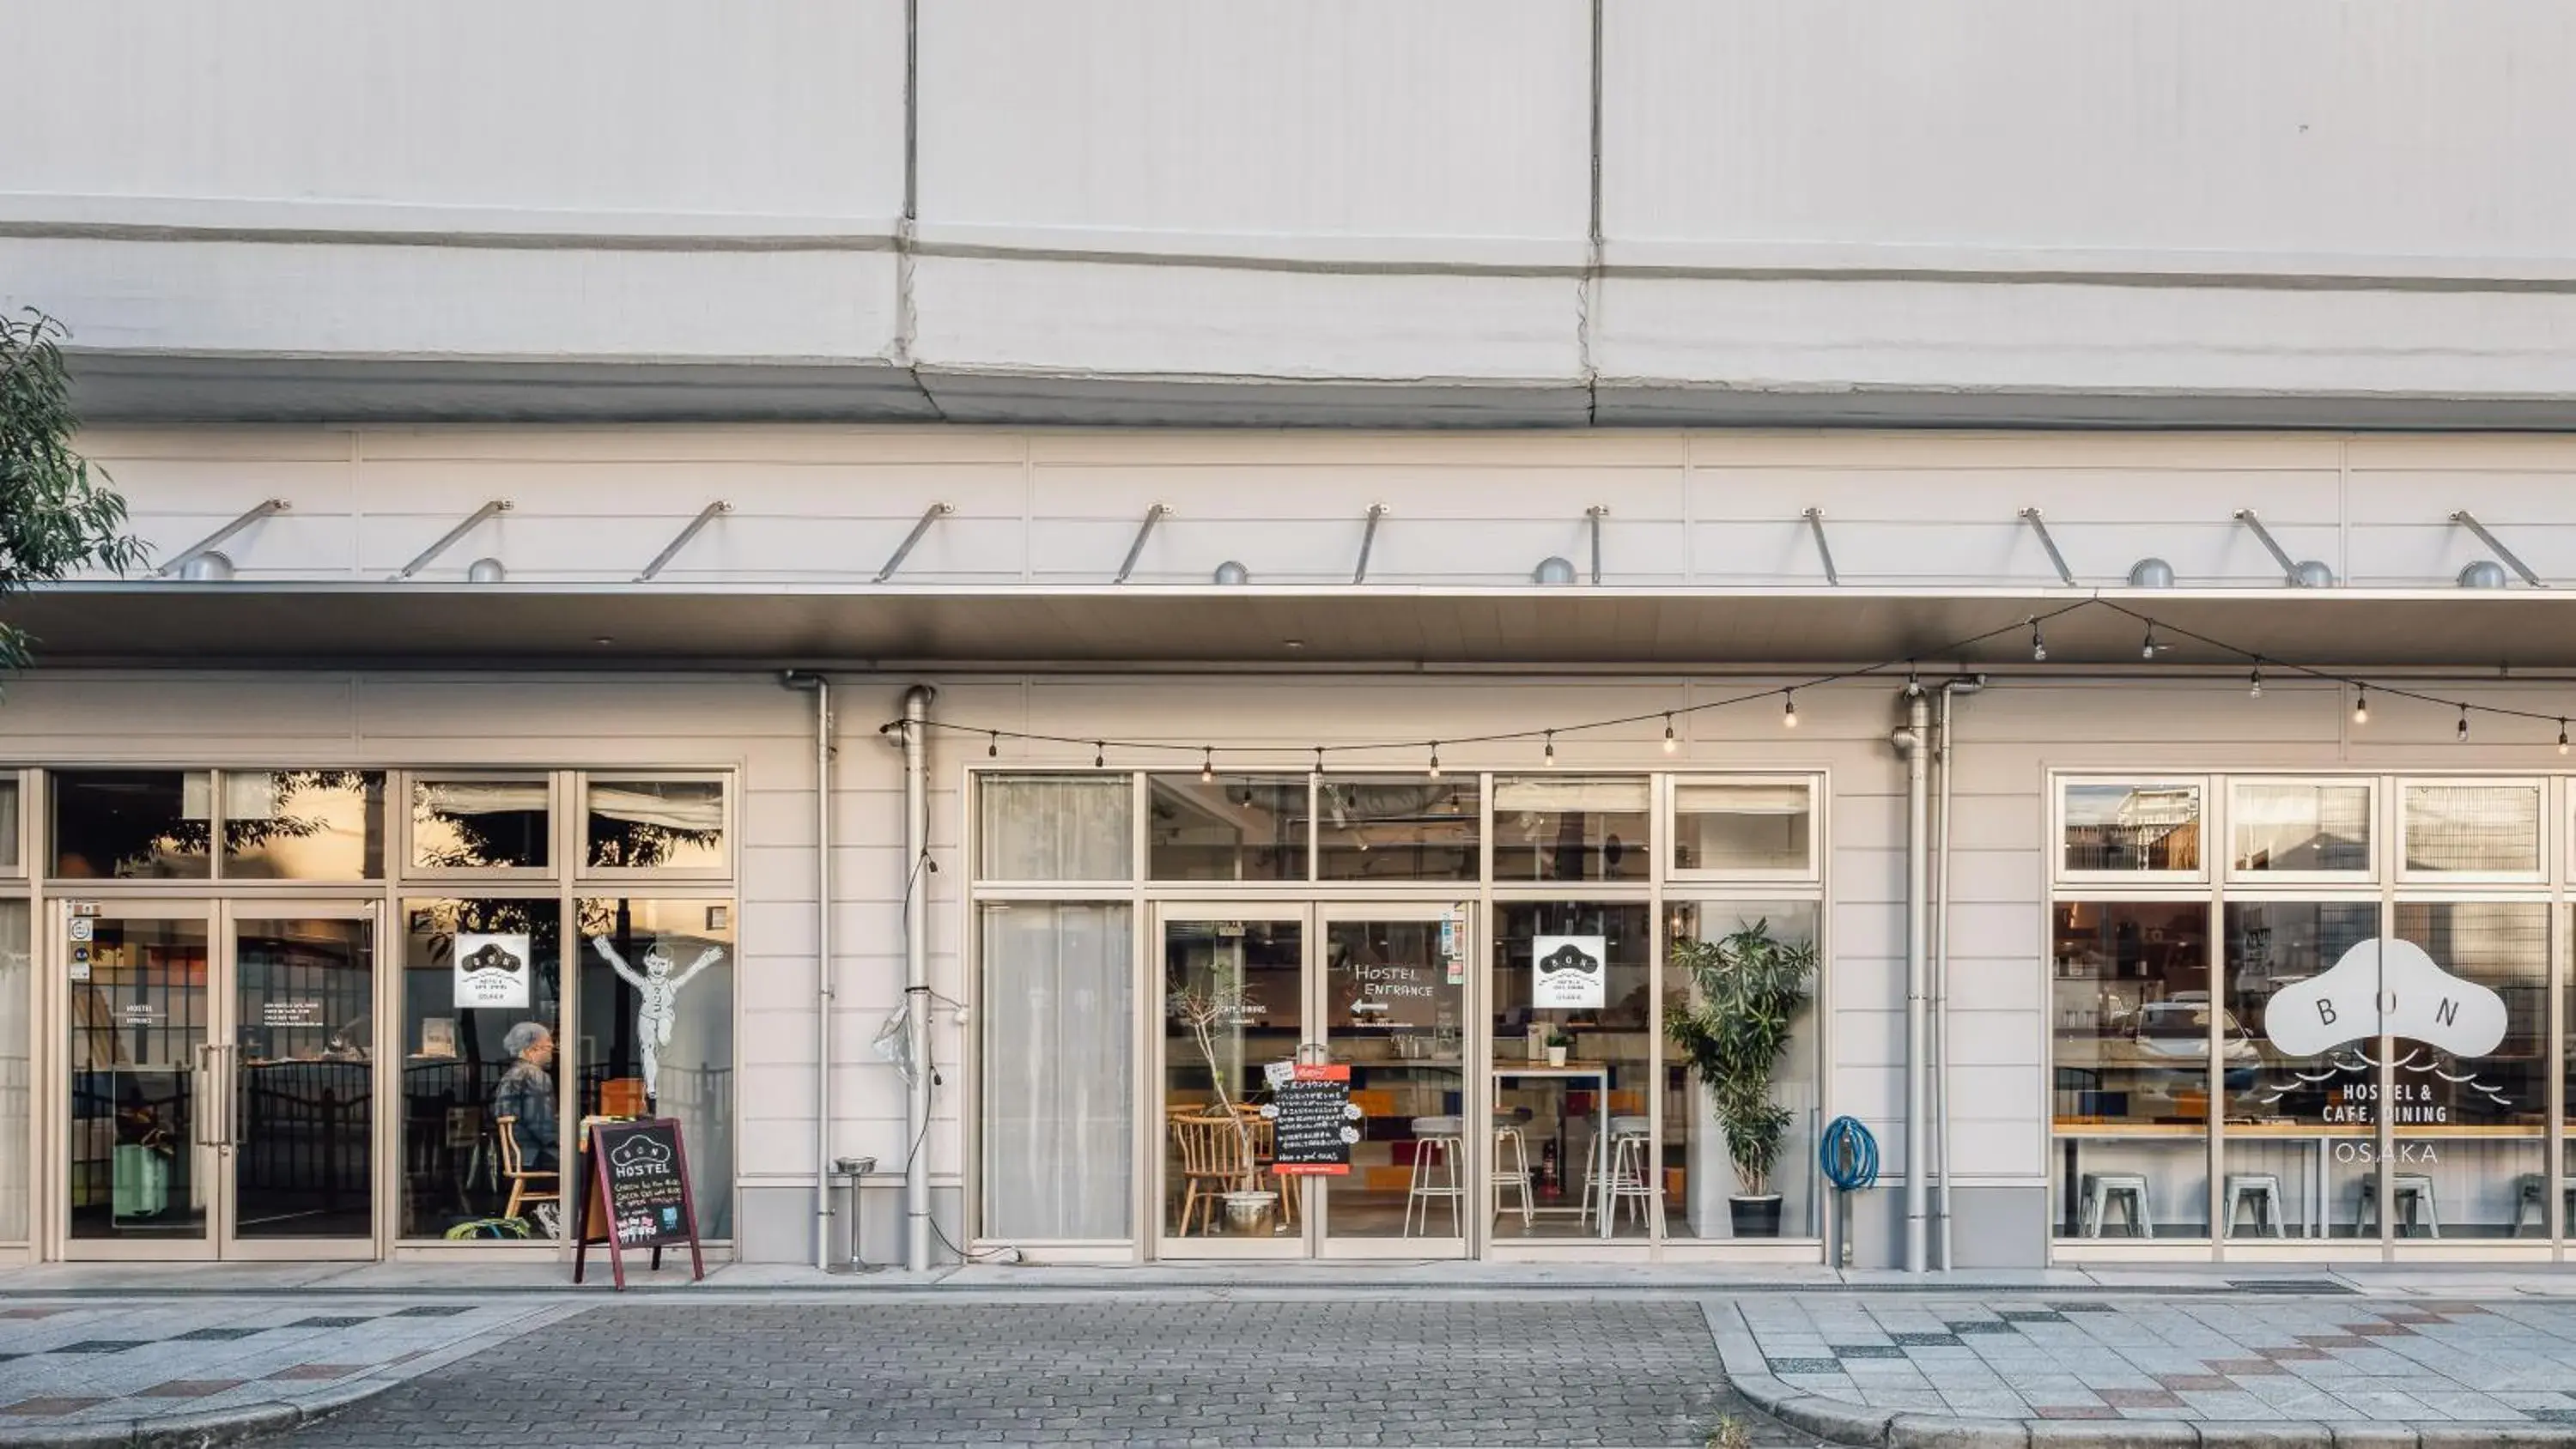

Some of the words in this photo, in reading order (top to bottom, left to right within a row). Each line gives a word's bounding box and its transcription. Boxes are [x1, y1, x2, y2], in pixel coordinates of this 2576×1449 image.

[1355, 964, 1419, 981] HOSTEL
[1364, 983, 1434, 997] ENTRANCE
[2316, 989, 2459, 1028] BON
[2343, 1084, 2414, 1100] HOSTEL
[2420, 1084, 2432, 1100] &
[2323, 1106, 2374, 1125] CAFE,
[2383, 1106, 2447, 1122] DINING
[2335, 1143, 2438, 1163] OSAKA
[616, 1163, 670, 1179] HOSTEL
